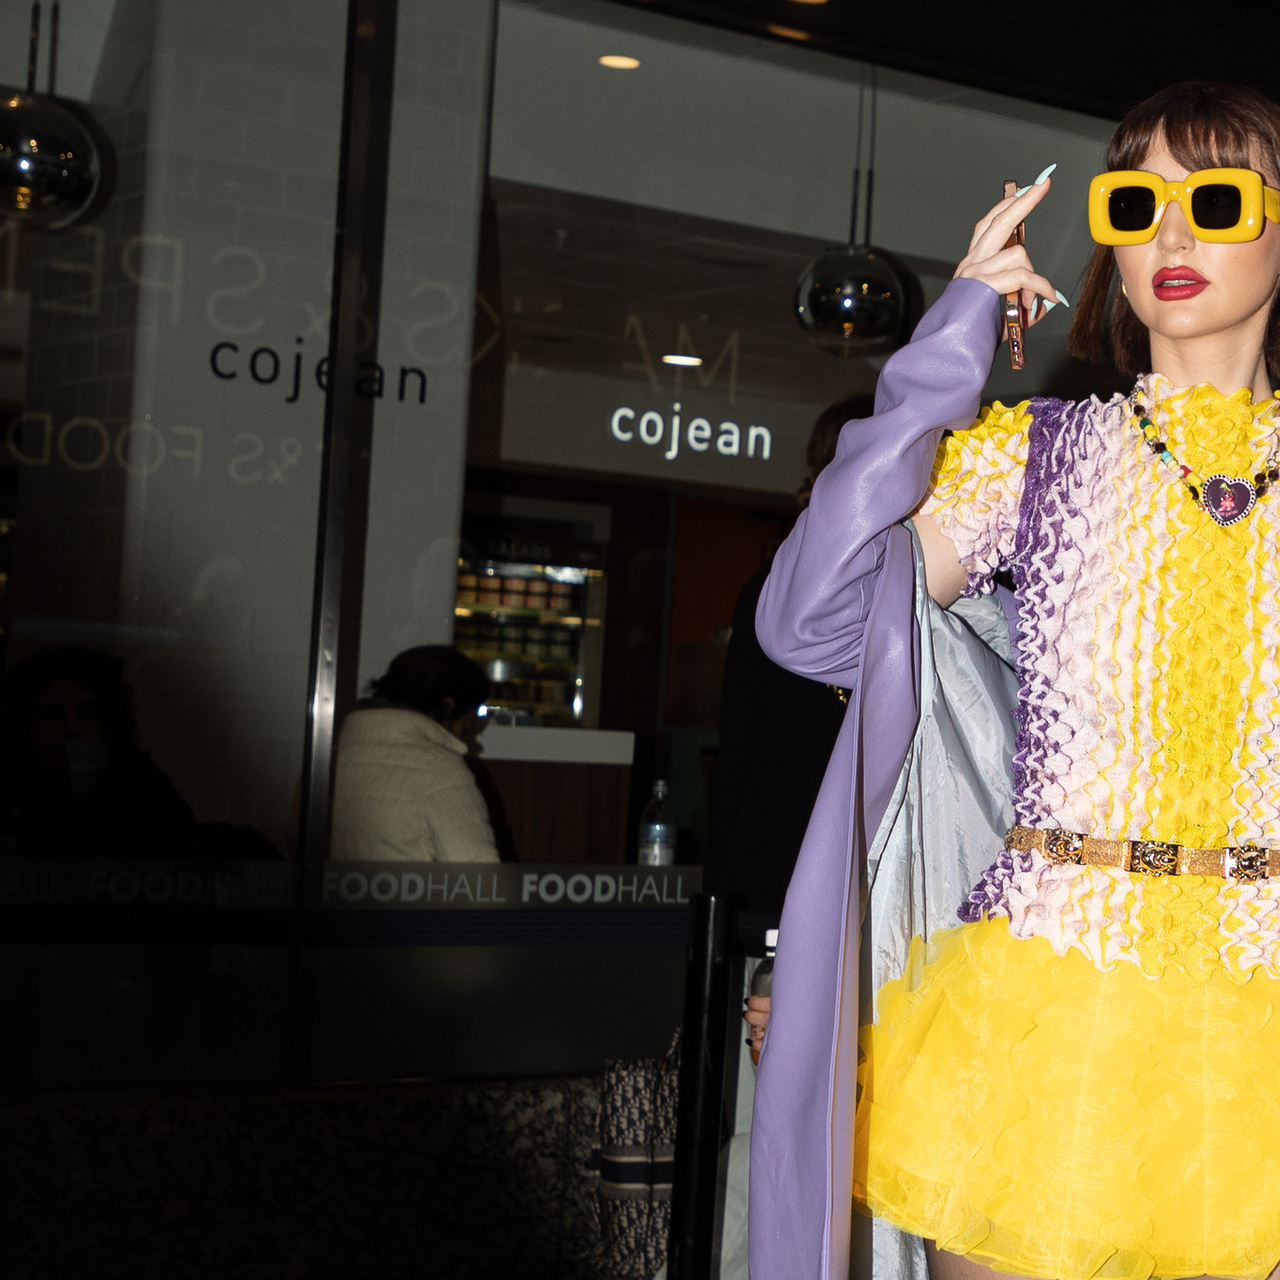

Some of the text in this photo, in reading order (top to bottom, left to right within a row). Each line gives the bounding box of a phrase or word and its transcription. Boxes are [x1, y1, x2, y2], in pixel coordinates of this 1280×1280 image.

[610, 401, 772, 461] cojean
[322, 871, 507, 904] FOODHALL
[521, 872, 691, 905] FOODHALL
